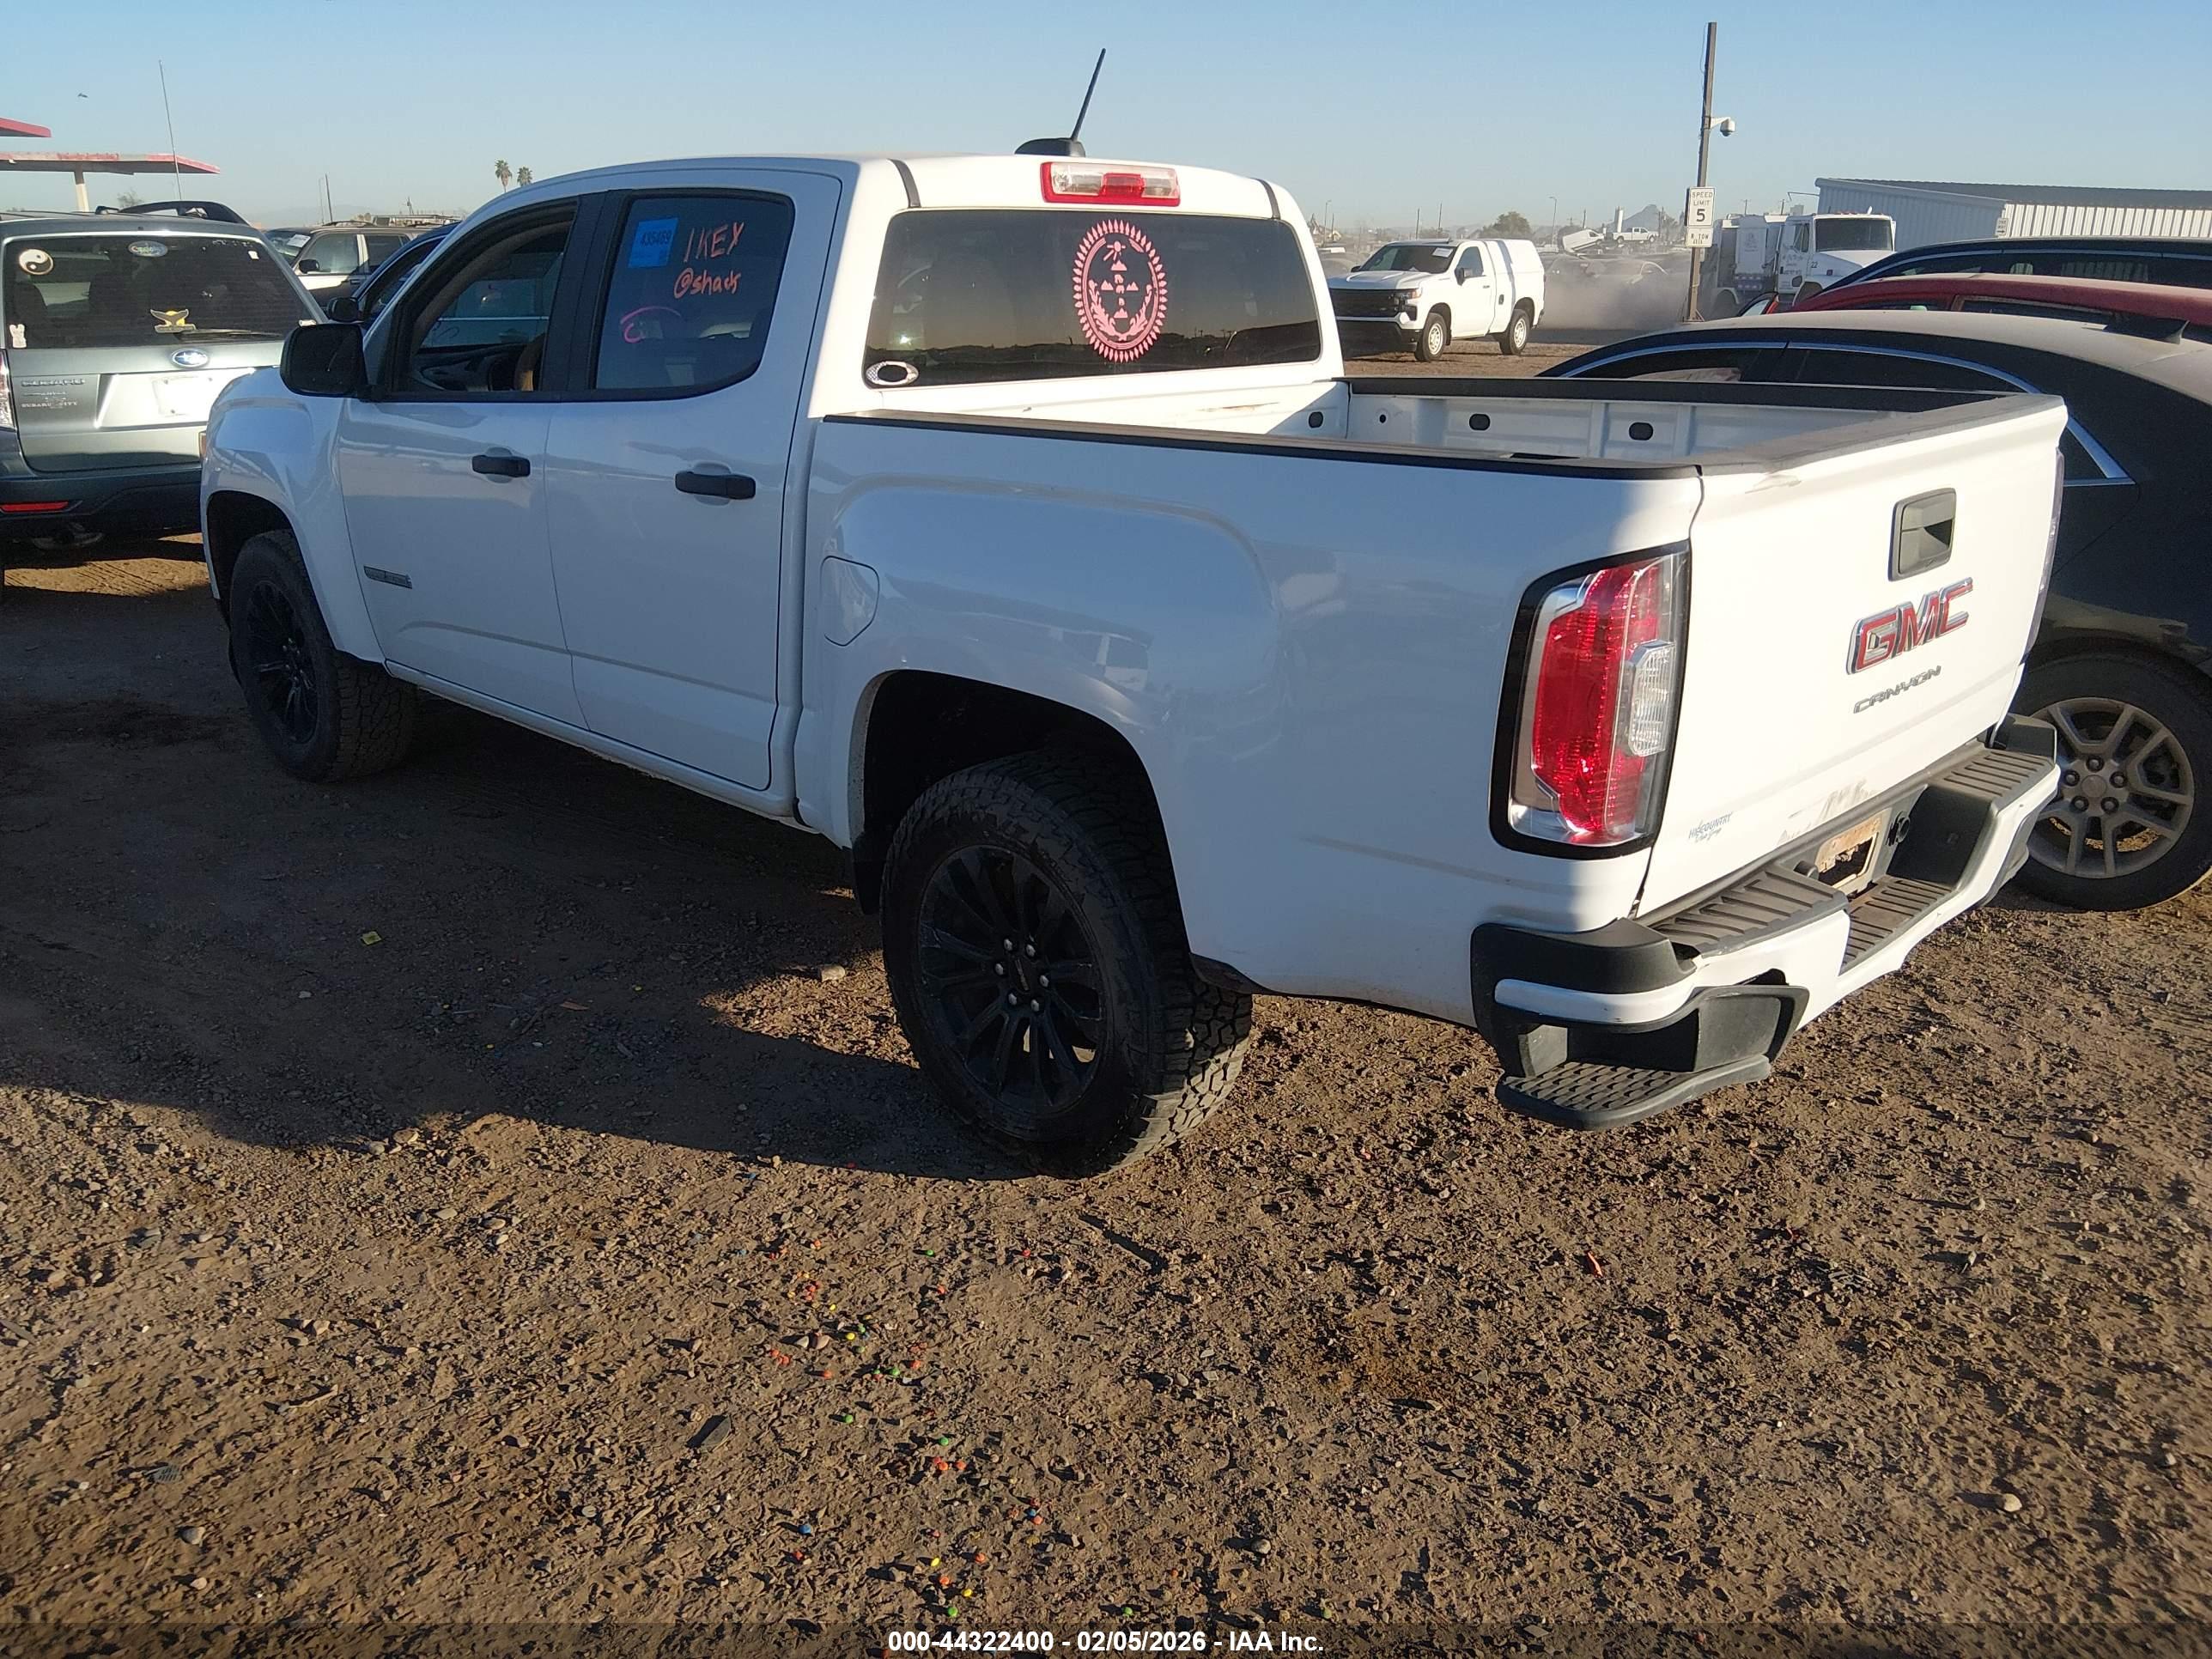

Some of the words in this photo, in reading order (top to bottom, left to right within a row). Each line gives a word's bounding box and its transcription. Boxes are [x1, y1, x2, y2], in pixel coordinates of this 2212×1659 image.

[1696, 209, 1705, 222] 5
[1846, 576, 1973, 675] GMC
[1853, 665, 1942, 714] CANYON
